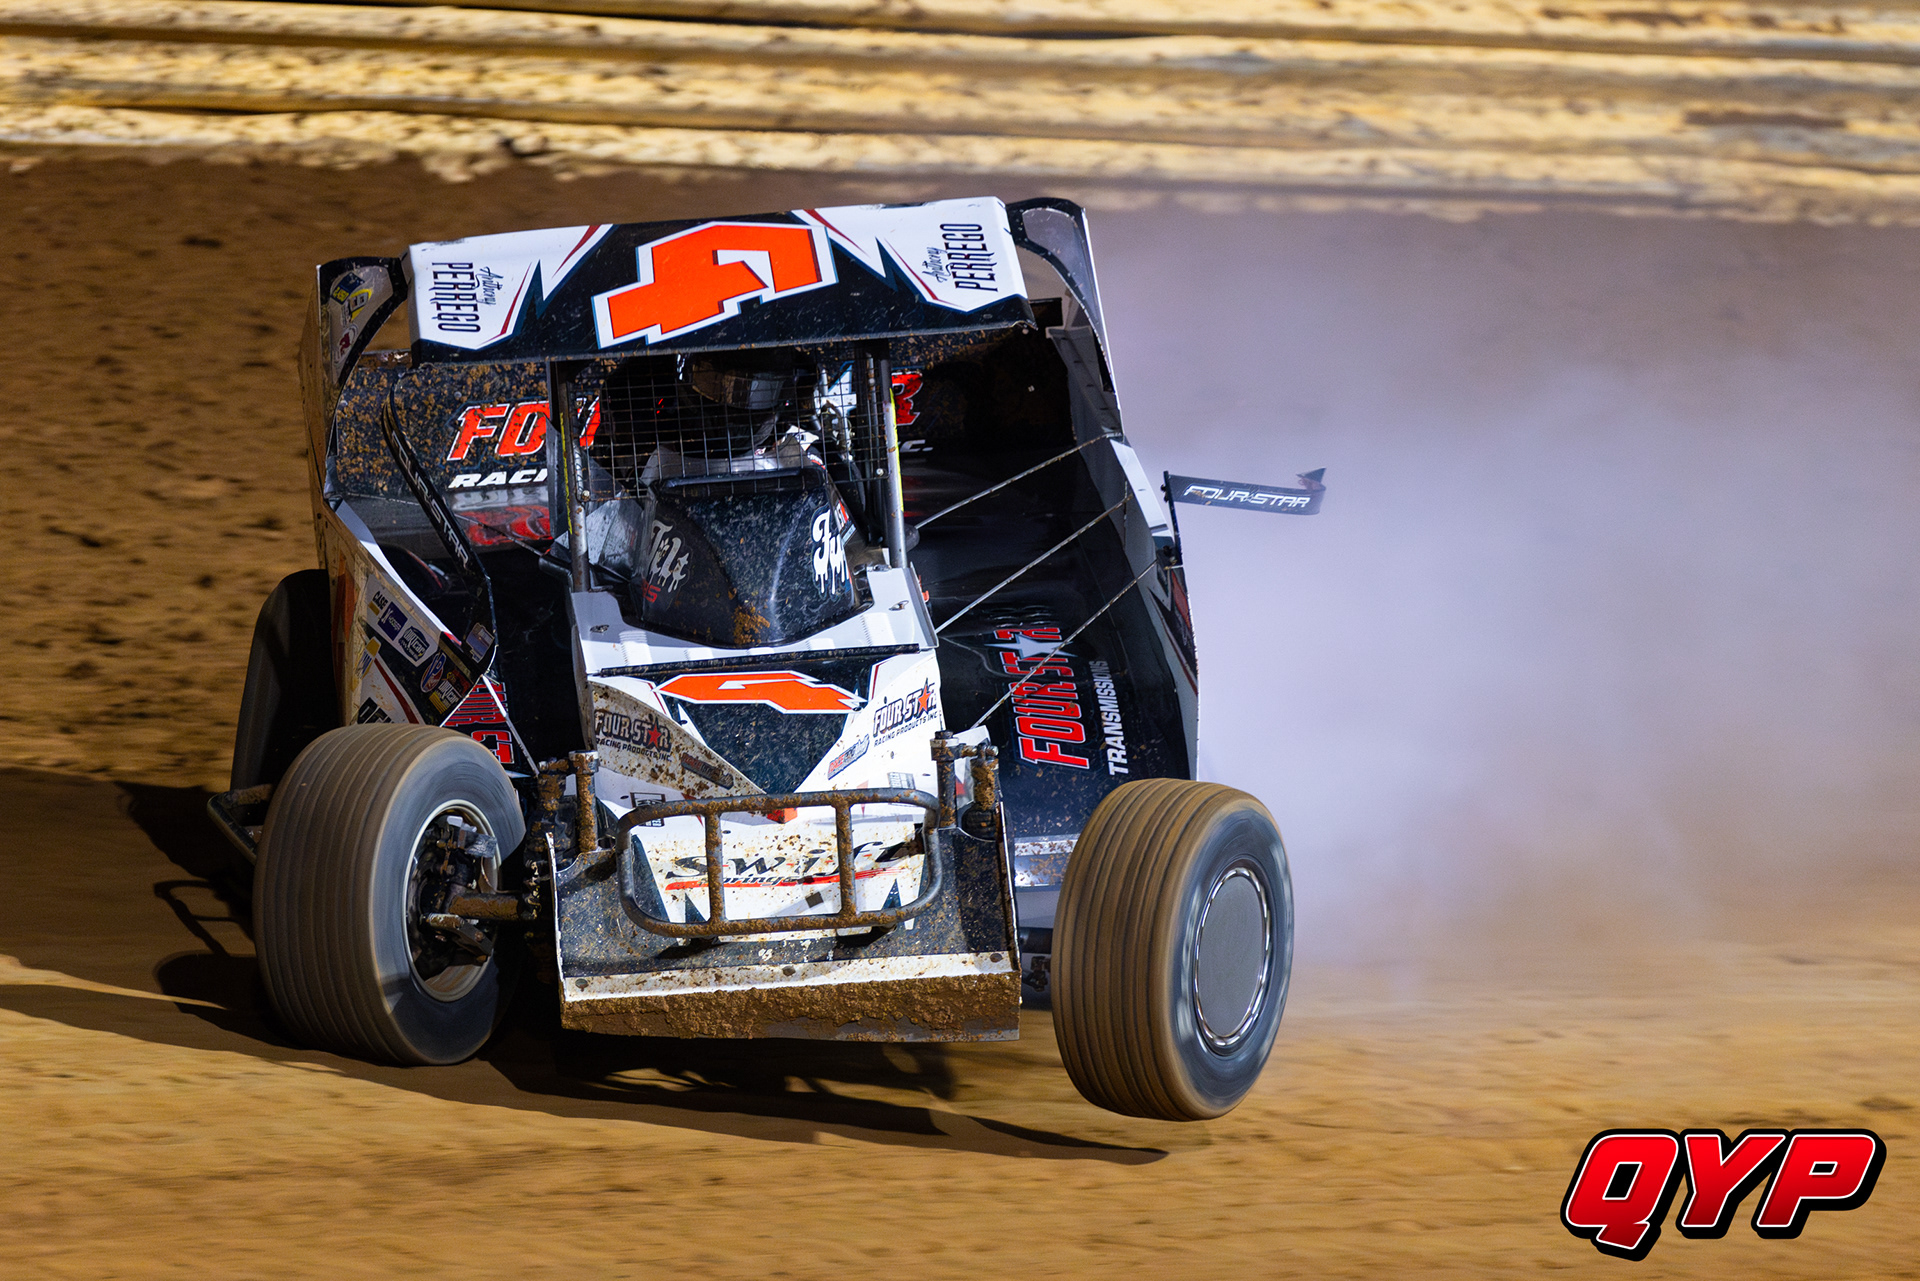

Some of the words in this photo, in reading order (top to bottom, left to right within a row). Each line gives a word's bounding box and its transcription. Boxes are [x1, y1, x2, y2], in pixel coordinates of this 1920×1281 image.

[940, 223, 998, 292] PERREGO
[429, 262, 481, 332] PERREGO
[1183, 484, 1248, 502] FOUR
[1250, 493, 1310, 507] STAR
[372, 591, 389, 610] CASE
[594, 709, 631, 742] FOUR
[873, 698, 905, 738] FOUR
[874, 728, 896, 747] RACING
[896, 715, 927, 738] PRODUCTS
[1008, 682, 1089, 769] FOUR
[1089, 660, 1129, 776] TRANSMISSIONS
[596, 737, 622, 751] RACING
